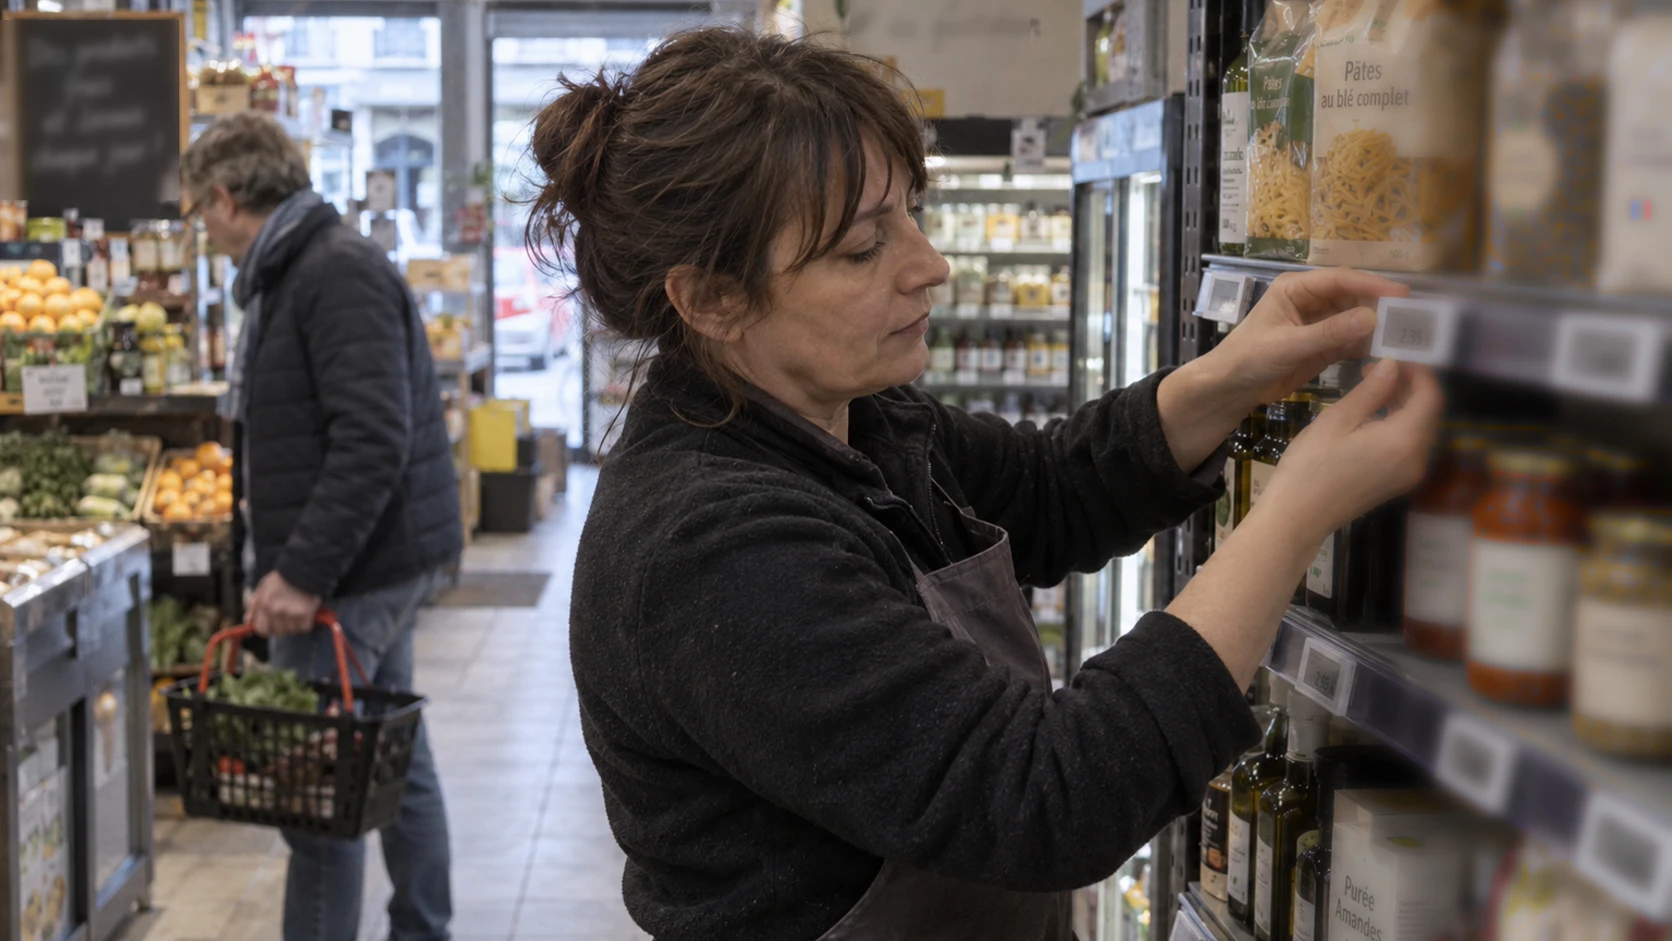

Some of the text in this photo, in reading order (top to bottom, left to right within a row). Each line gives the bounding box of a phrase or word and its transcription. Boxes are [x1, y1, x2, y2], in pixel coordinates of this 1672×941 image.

[1344, 60, 1382, 81] Pâtes
[1321, 86, 1410, 111] au blé complet
[1344, 875, 1375, 912] Purée
[1335, 898, 1382, 941] Amandes
